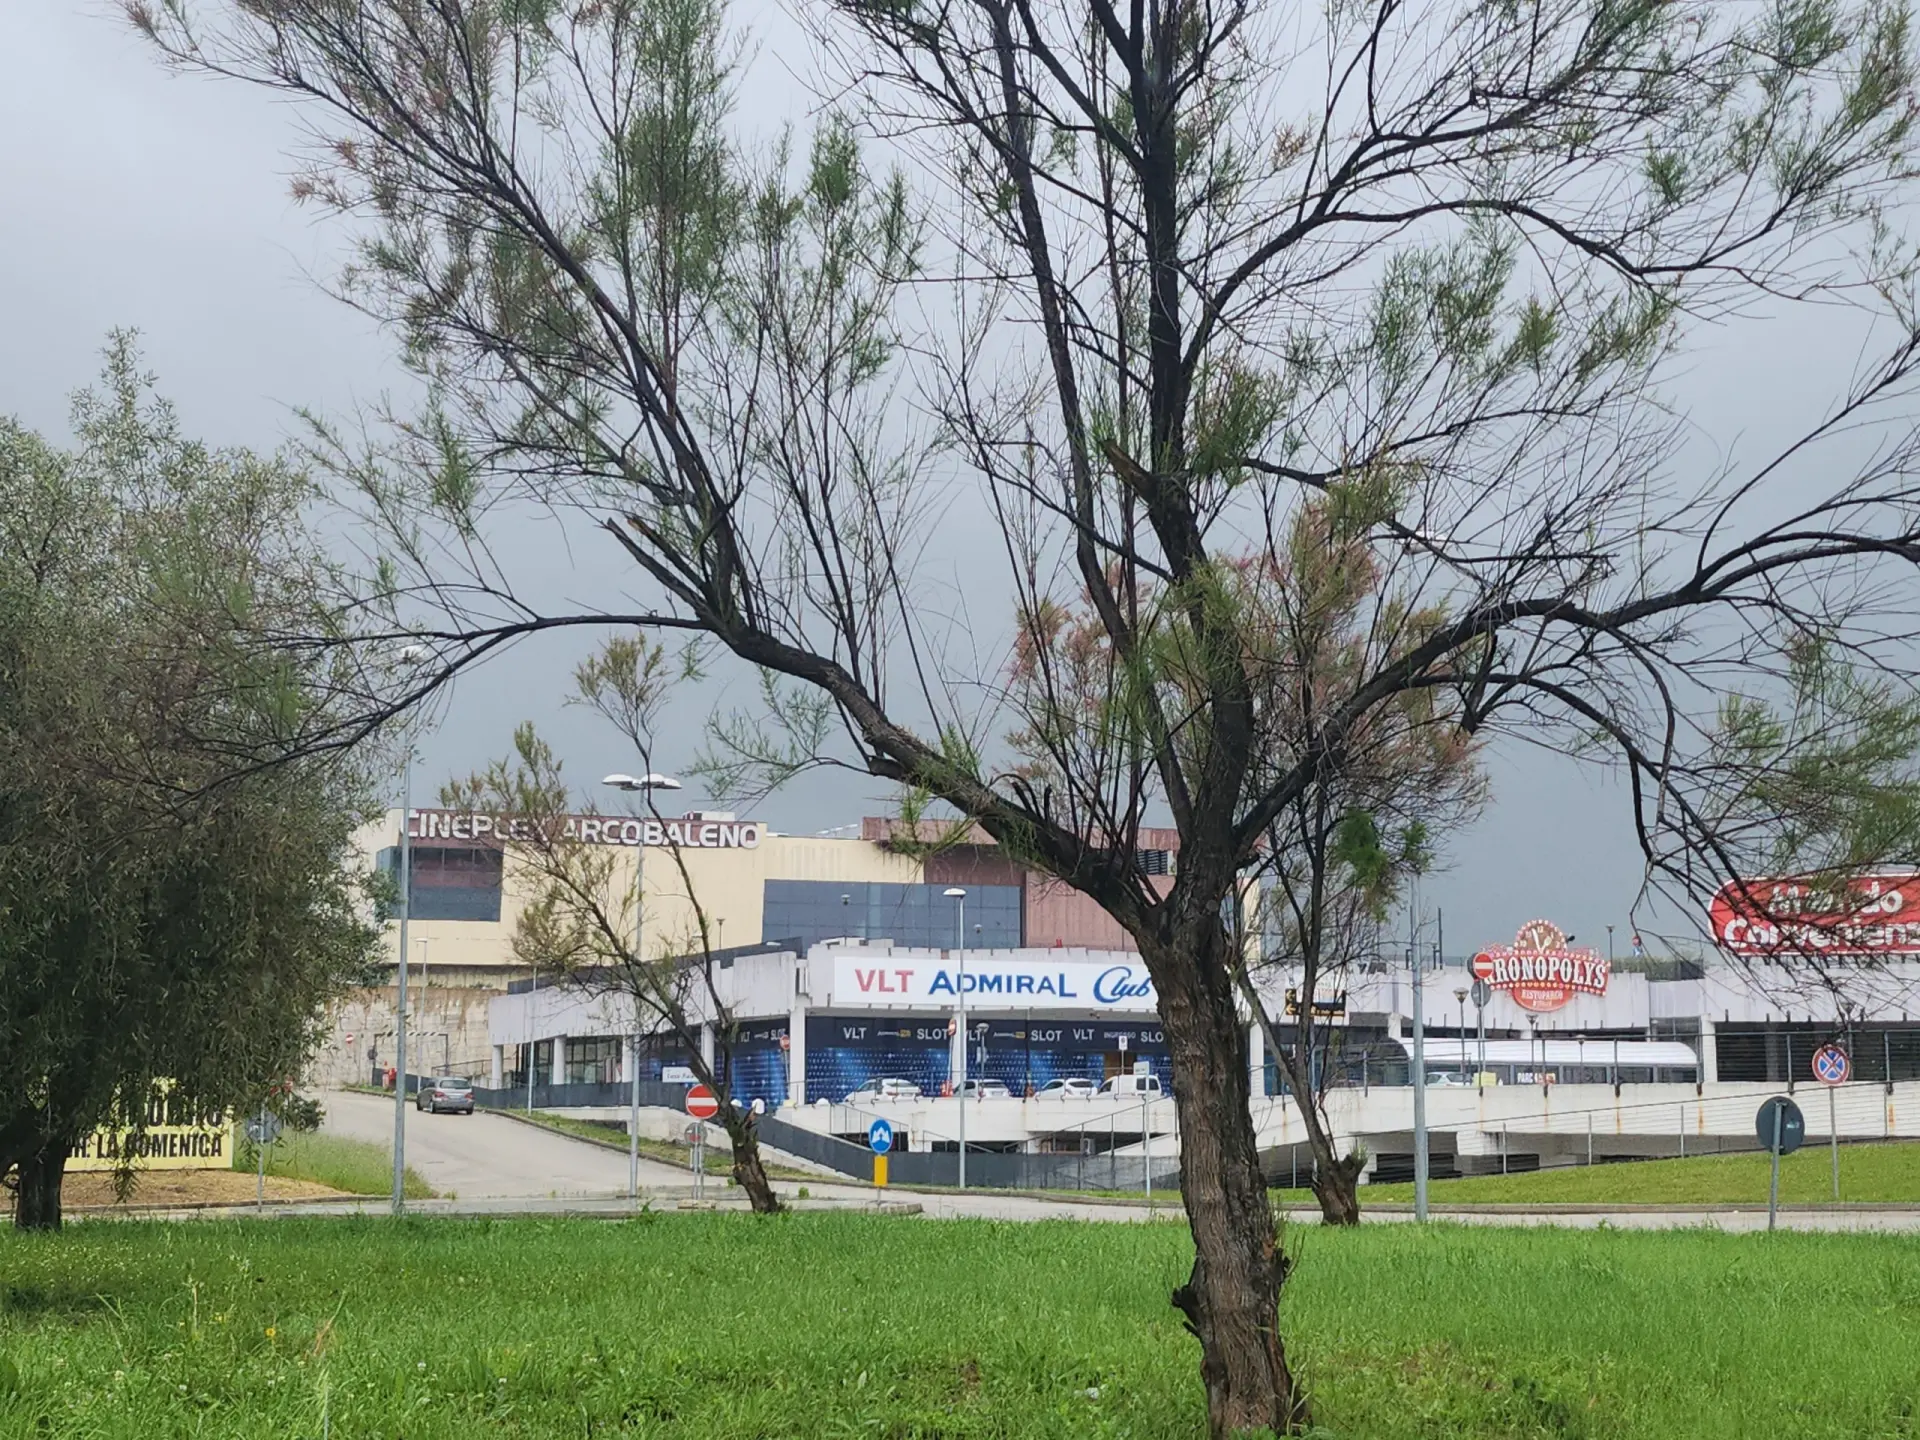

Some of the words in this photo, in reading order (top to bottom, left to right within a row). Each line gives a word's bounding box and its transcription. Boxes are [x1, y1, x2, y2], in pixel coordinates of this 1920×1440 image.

[562, 819, 760, 849] ARCOBALENO
[1767, 881, 1903, 914] Modo
[854, 968, 914, 993] VLT
[928, 970, 1077, 998] ADMIRAL
[1093, 966, 1151, 1003] Club
[1484, 956, 1606, 989] RONOPOLYS
[843, 1027, 867, 1039] VLT
[917, 1028, 949, 1040] SLOT
[1031, 1029, 1063, 1042] SLOT
[1073, 1028, 1095, 1041] VLT
[97, 1133, 118, 1158] LA
